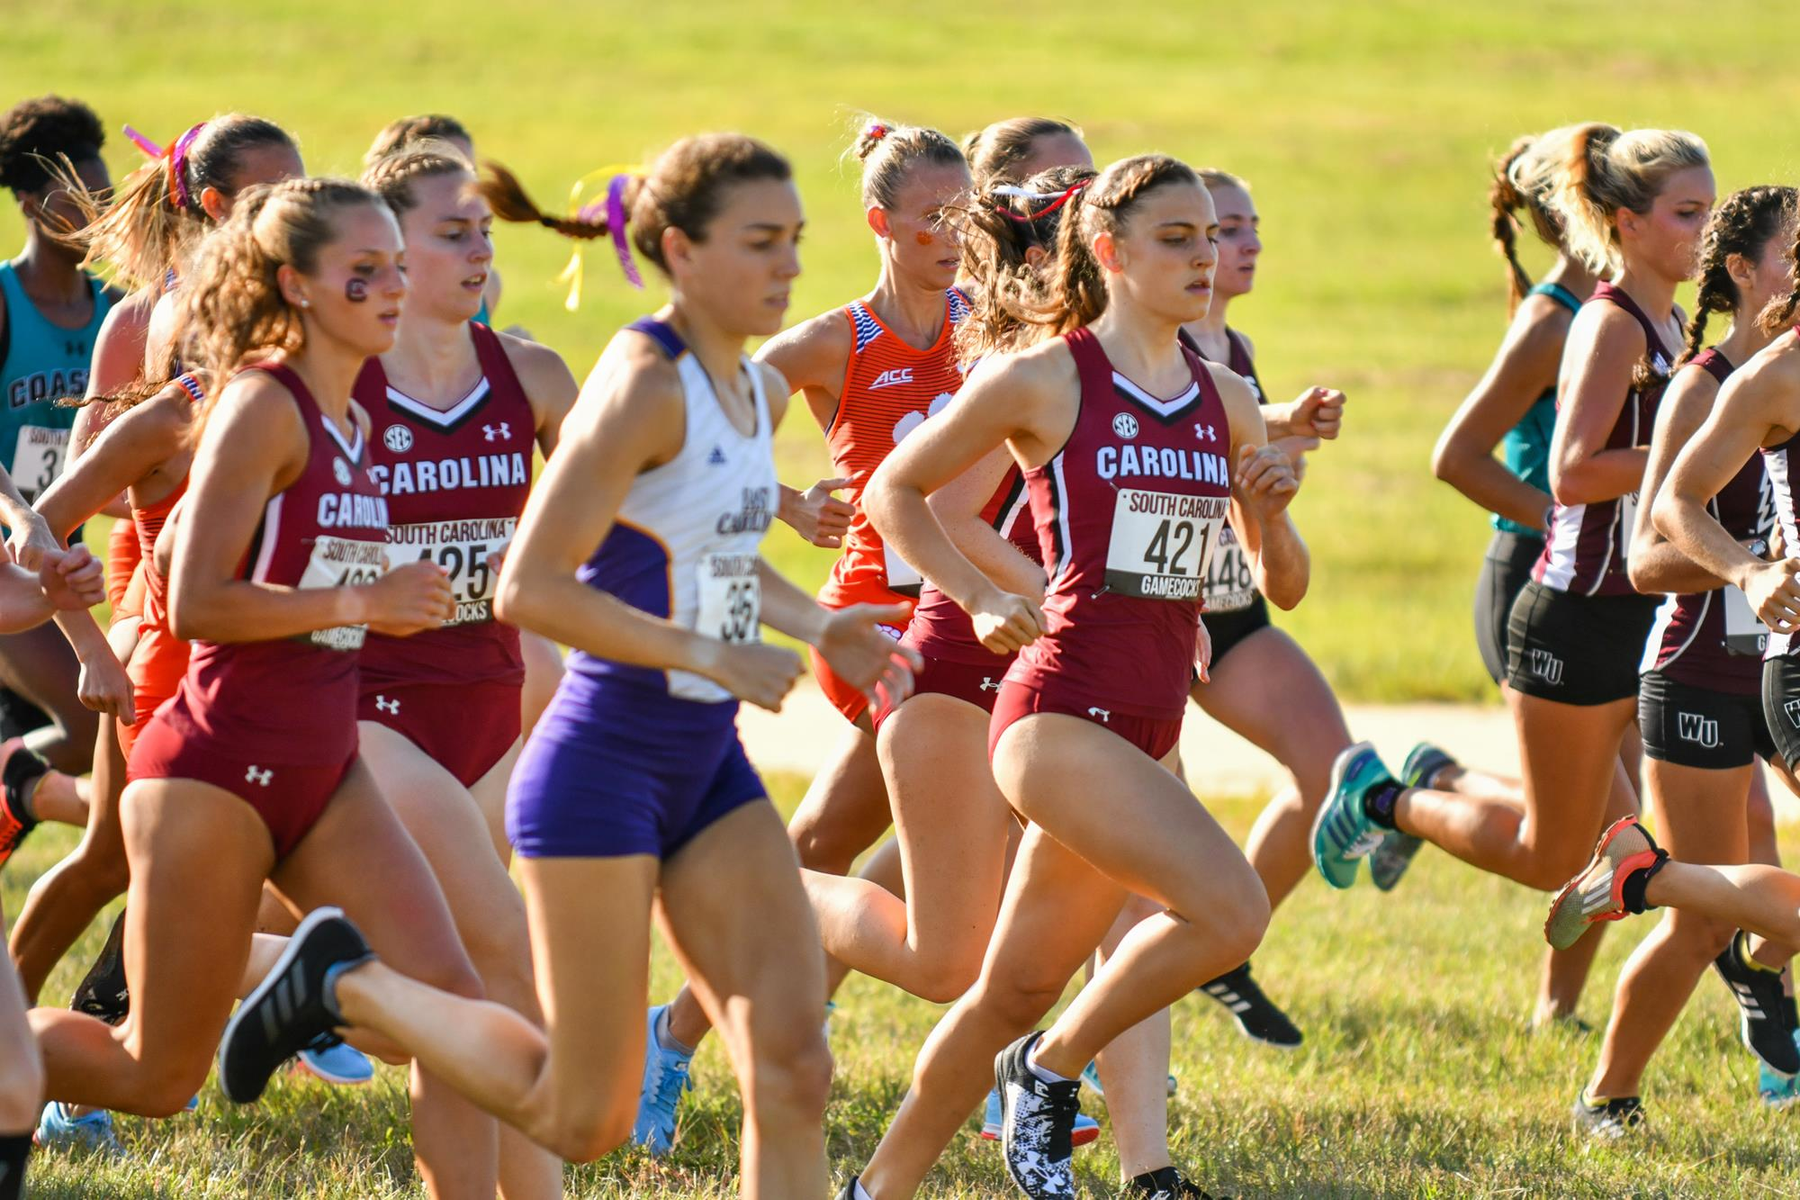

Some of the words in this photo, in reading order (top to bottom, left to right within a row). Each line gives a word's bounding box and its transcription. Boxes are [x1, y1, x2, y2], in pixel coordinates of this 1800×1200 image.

[8, 368, 90, 410] COAS
[870, 368, 914, 387] ACC
[385, 430, 411, 450] SEC
[1114, 414, 1138, 437] SEC
[372, 452, 527, 496] CAROLINA
[1097, 445, 1229, 488] CAROLINA
[1129, 492, 1176, 517] SOUTH
[1178, 495, 1228, 520] CAROLINA
[384, 524, 437, 545] SOUTH
[439, 518, 507, 542] CAROLINA
[1143, 519, 1211, 578] 421
[417, 543, 489, 600] 25
[1141, 575, 1201, 598] GAMECOCKS
[1531, 648, 1563, 686] WU
[1678, 711, 1719, 748] WU
